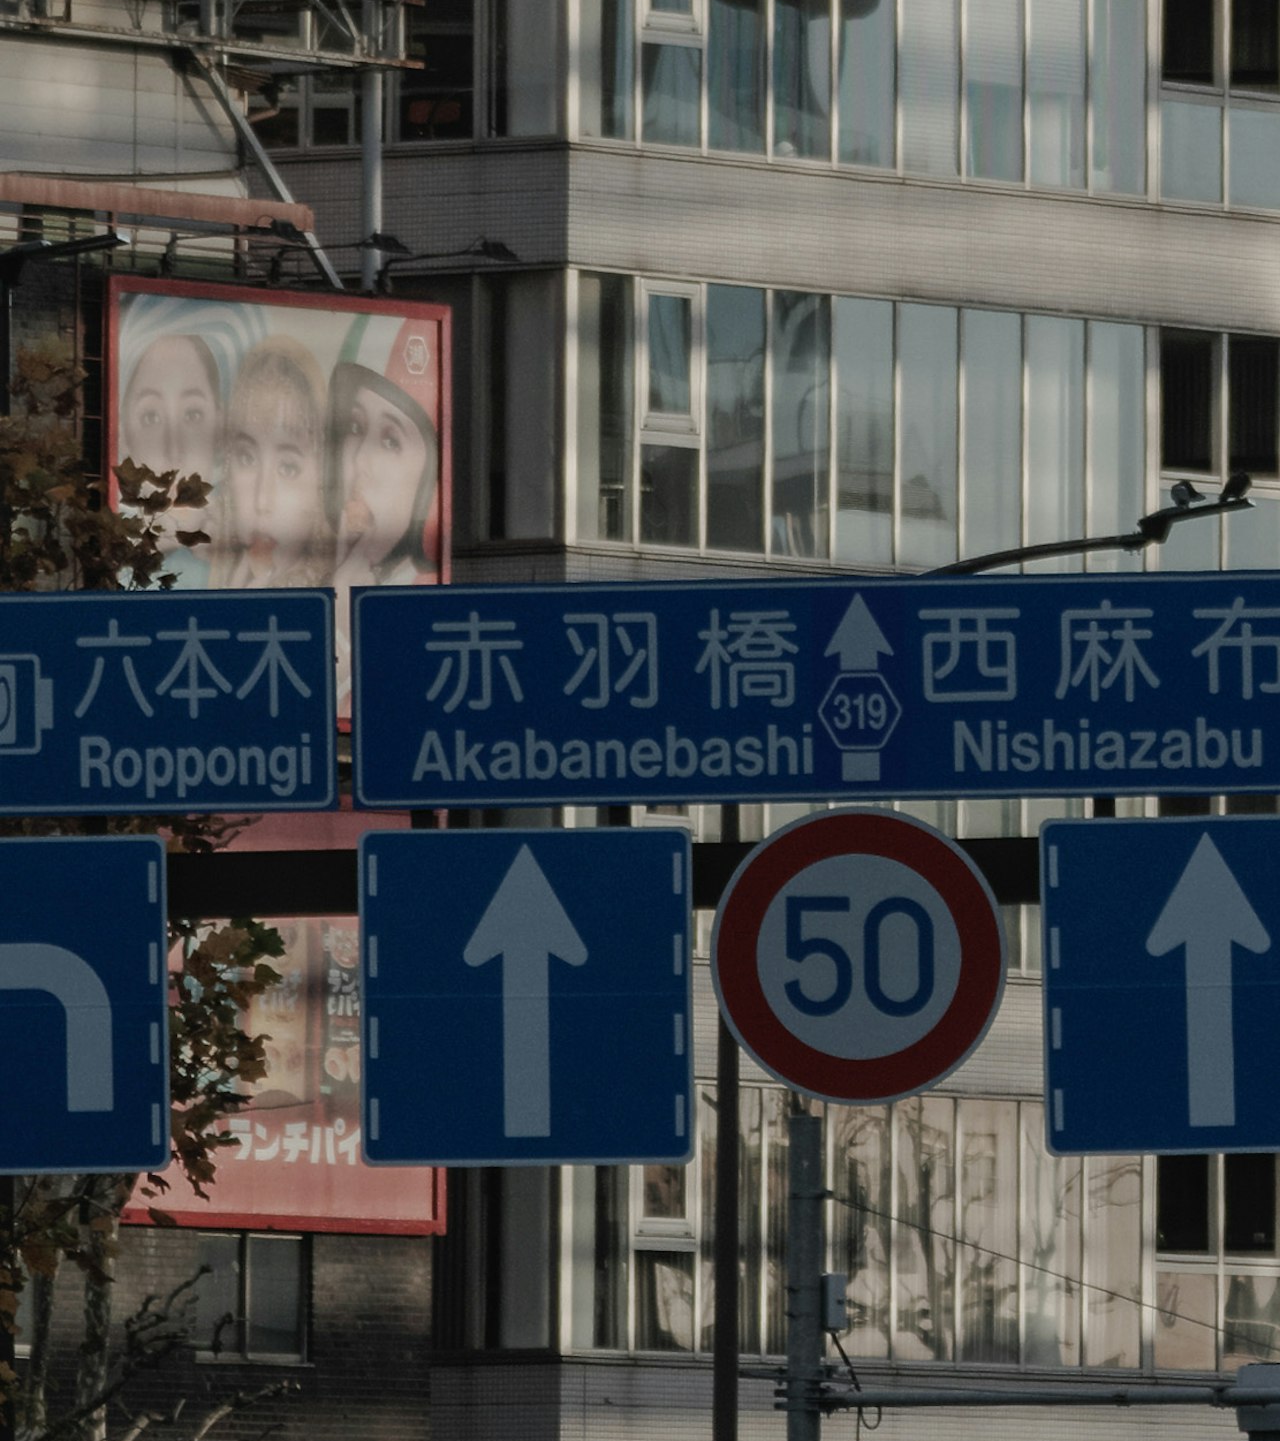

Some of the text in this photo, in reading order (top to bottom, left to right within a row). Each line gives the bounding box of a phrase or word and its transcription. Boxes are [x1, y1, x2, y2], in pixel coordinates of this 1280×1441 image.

[75, 614, 312, 720] 六本木
[425, 610, 798, 713] 赤羽橋
[412, 716, 1263, 784] Akabanebashi Nishiazabu
[832, 692, 887, 731] 319
[79, 732, 312, 799] Roppongi
[784, 896, 935, 1017] 50
